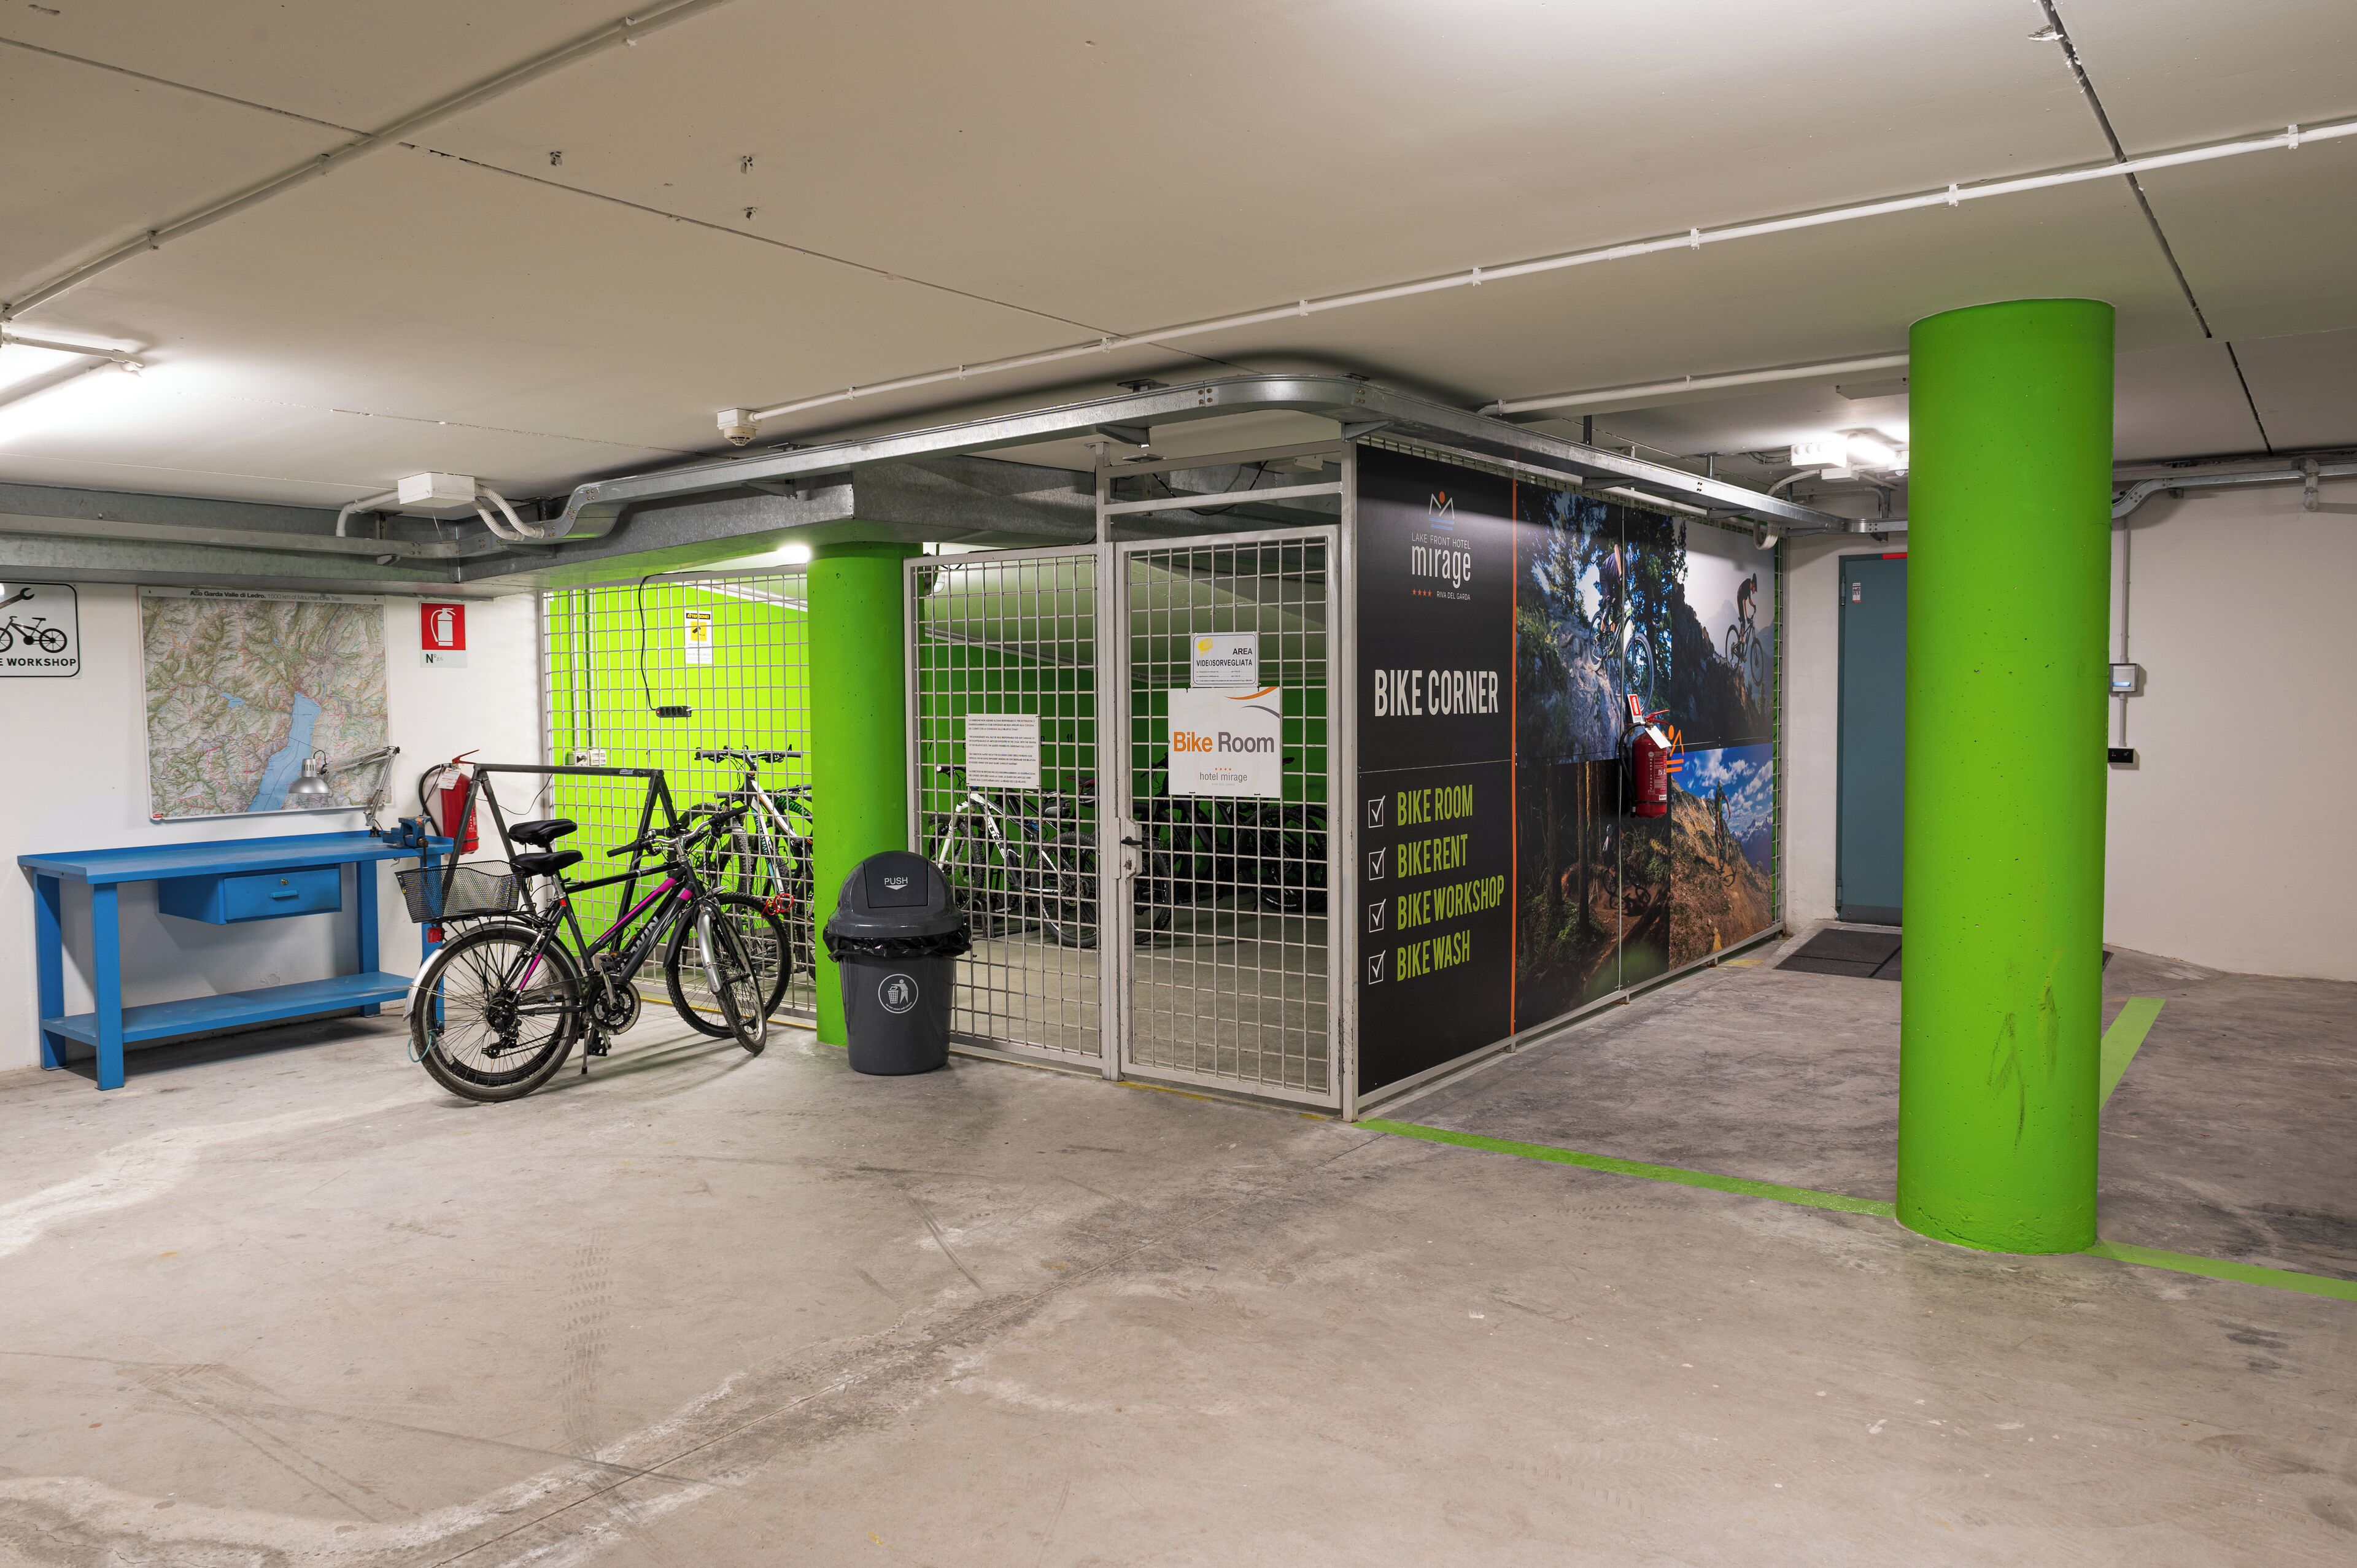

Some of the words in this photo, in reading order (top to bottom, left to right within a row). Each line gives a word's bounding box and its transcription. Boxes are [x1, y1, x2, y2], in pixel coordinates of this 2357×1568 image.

[1412, 532, 1428, 543] LAKE
[1430, 535, 1450, 546] FRONT
[1452, 538, 1471, 550] HOTEL
[1412, 546, 1471, 589] mirage
[7, 658, 76, 666] WORKSHOP
[1375, 669, 1423, 717] BIKE
[1428, 670, 1498, 716] CORNER
[1174, 732, 1213, 752] Bike
[1218, 732, 1275, 753] Room
[1199, 772, 1218, 781] hotel
[1221, 772, 1247, 783] mirage
[1398, 789, 1431, 826] BIKE
[1435, 784, 1473, 821] ROOM
[1398, 840, 1431, 878] BIKE
[1433, 833, 1468, 871] RENT
[1398, 890, 1431, 930] BIKE
[1433, 875, 1504, 921] WORKSHOP
[1397, 940, 1430, 981] BIKE
[1433, 929, 1470, 971] WASH
